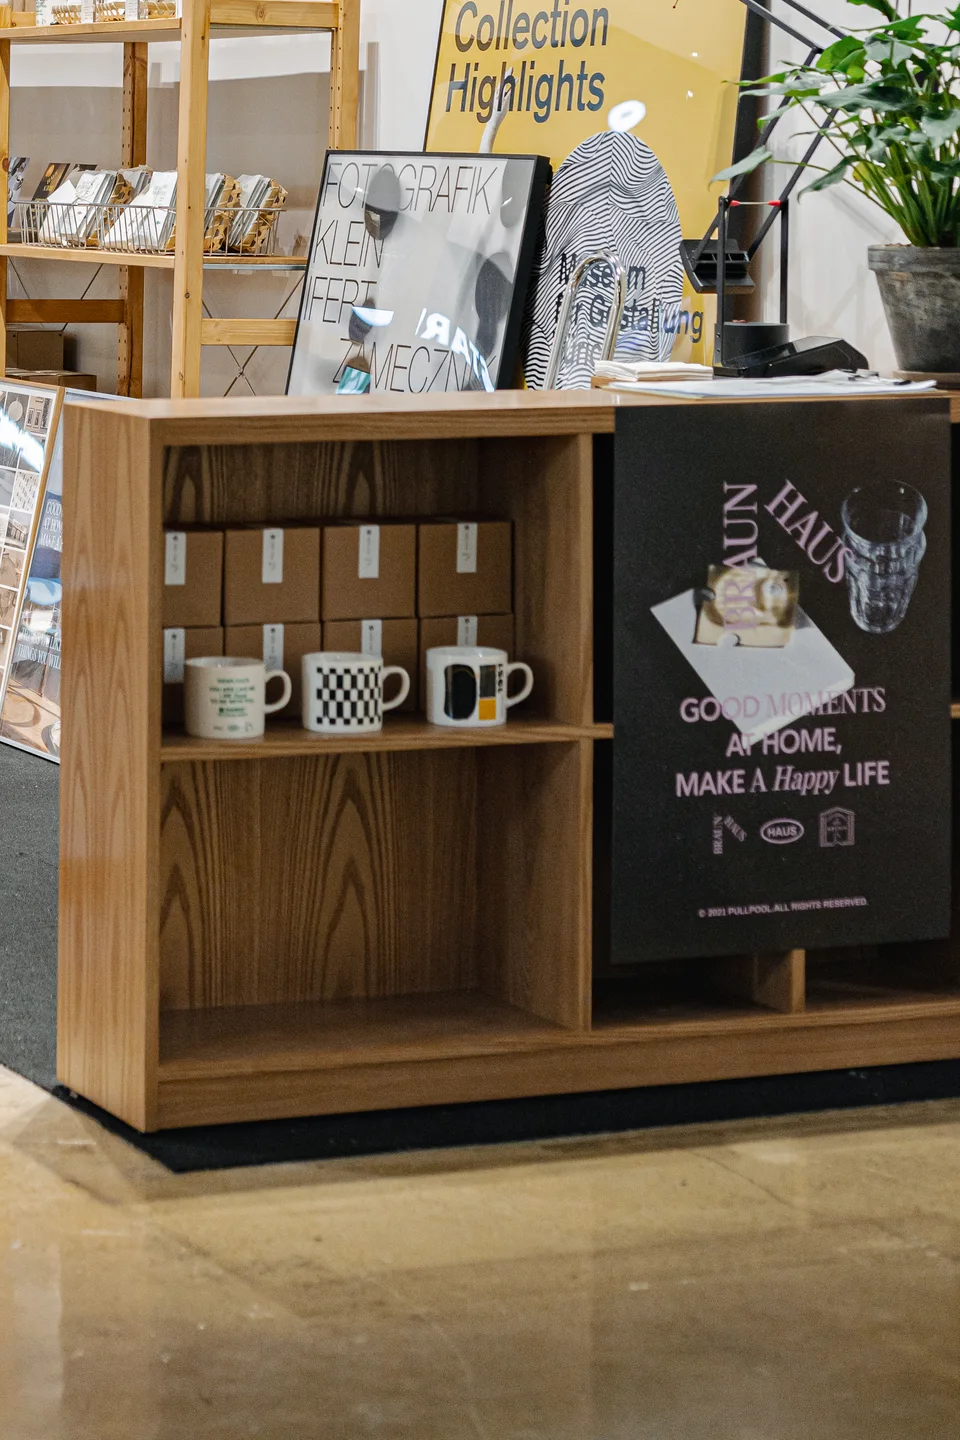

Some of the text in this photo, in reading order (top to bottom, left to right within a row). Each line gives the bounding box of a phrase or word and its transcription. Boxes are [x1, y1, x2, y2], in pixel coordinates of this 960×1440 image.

[445, 59, 606, 123] Highlights
[322, 161, 498, 215] FOTGRAFIK
[313, 218, 386, 268] KLEIN
[303, 276, 377, 324] IFERT
[722, 479, 854, 632] BRAUN HAUS
[48, 654, 61, 669] WIL
[49, 636, 61, 652] LIK
[680, 687, 887, 723] GOOD MOMENTS
[726, 726, 843, 758] AT HOME,
[675, 761, 891, 798] MAKE A Happy LIFE
[713, 813, 748, 855] BRAUN HAUS
[767, 825, 798, 838] HAUS
[708, 908, 727, 918] 2021
[773, 903, 790, 913] ALL
[791, 900, 822, 910] RIGHTS
[823, 896, 869, 909] RESERVED.
